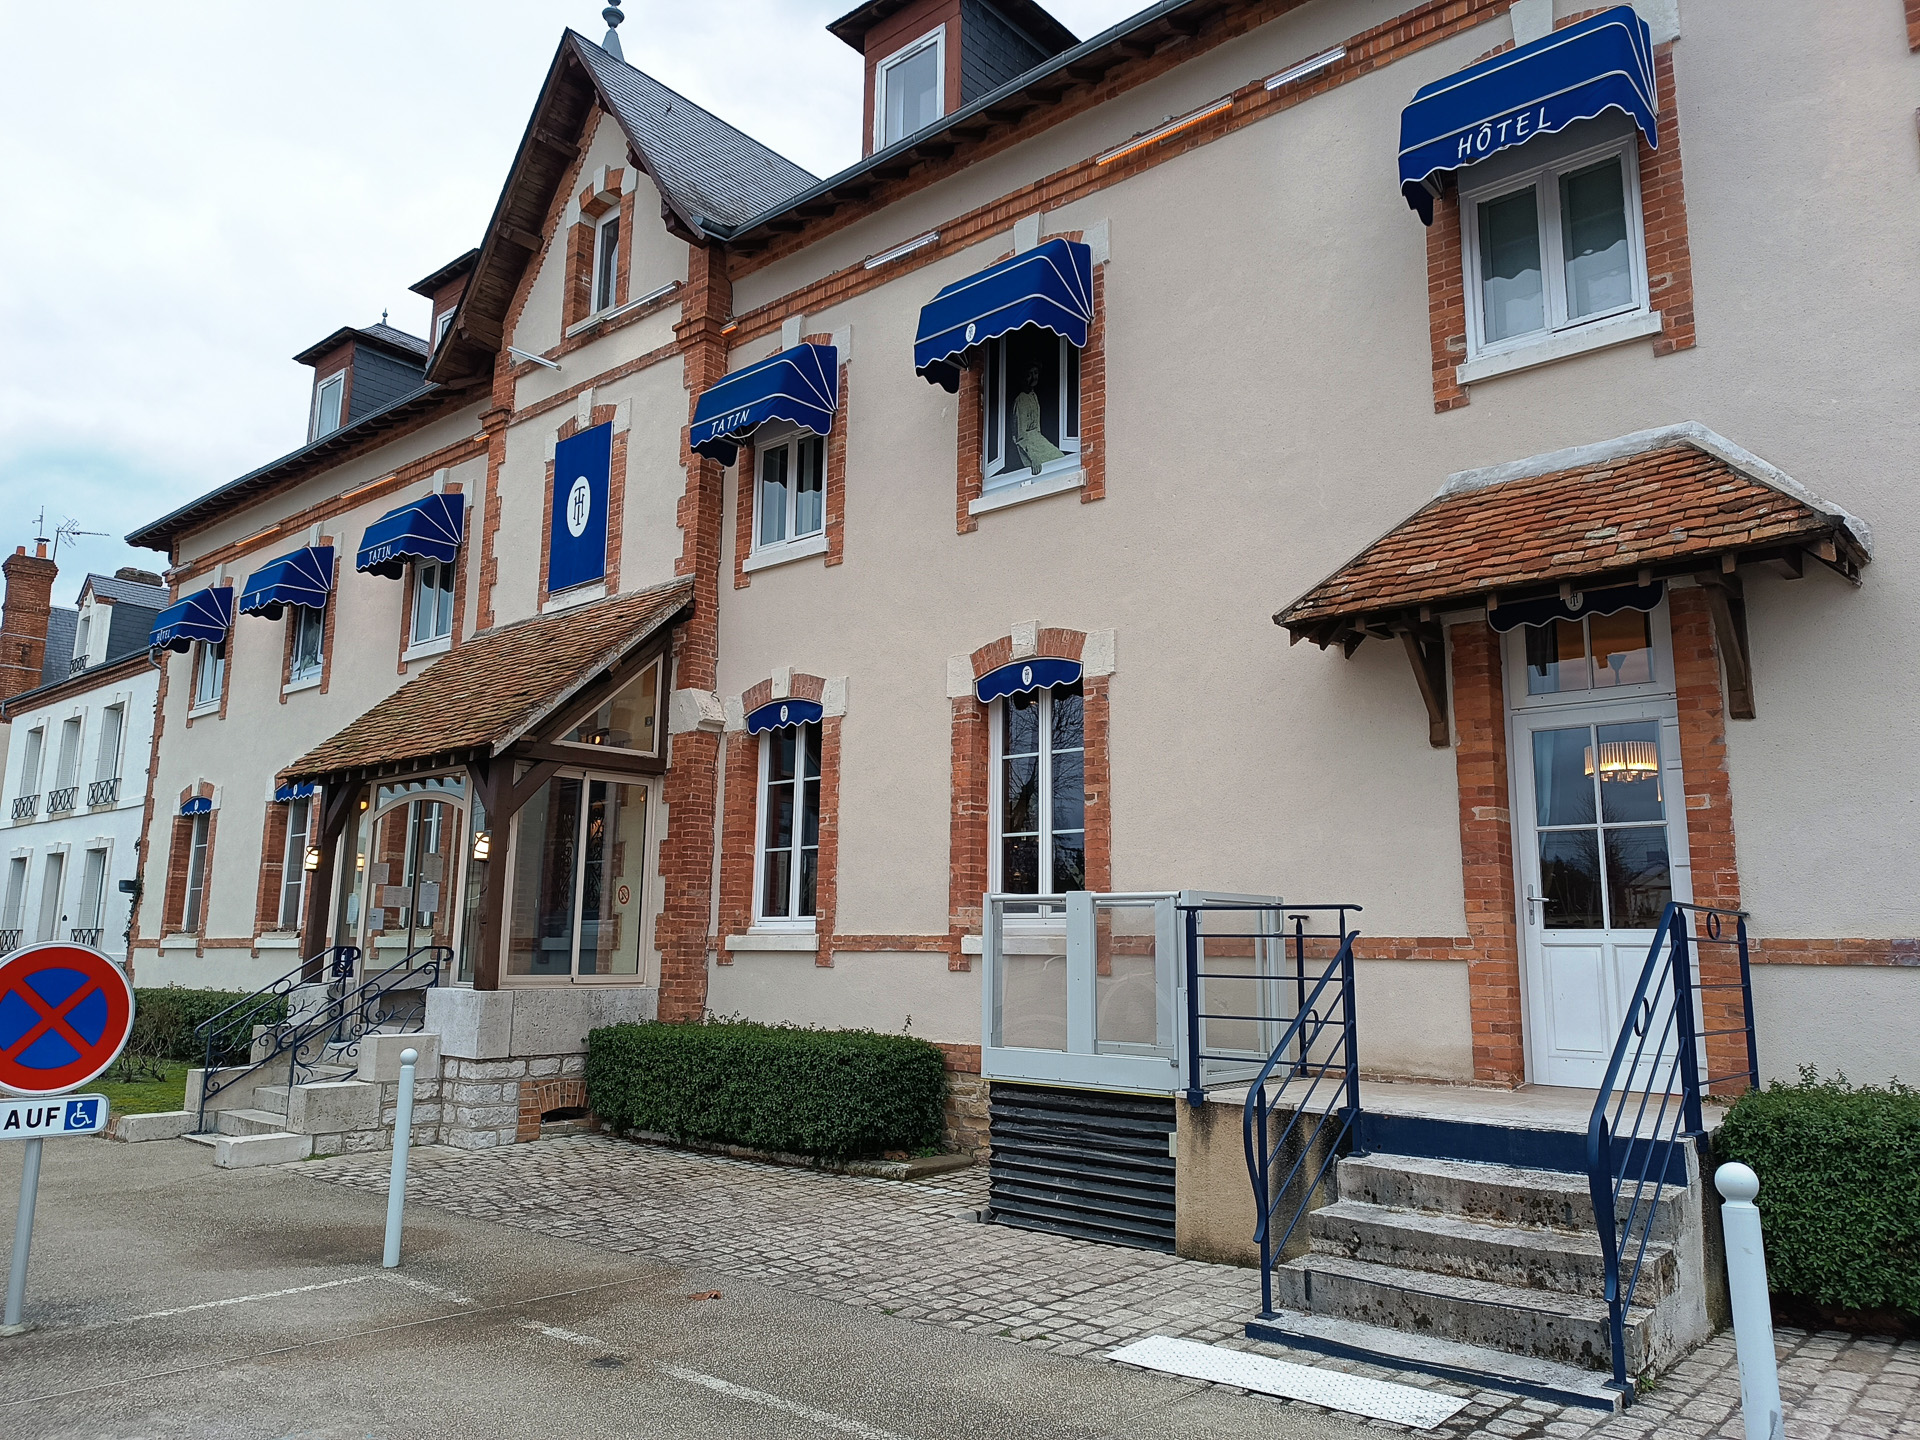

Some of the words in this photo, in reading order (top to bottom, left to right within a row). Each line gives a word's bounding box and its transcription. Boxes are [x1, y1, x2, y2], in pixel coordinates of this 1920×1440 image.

[1457, 107, 1552, 158] HÔTEL
[711, 408, 750, 435] TATIN
[368, 544, 392, 562] TATIN
[3, 1106, 61, 1131] AUF
